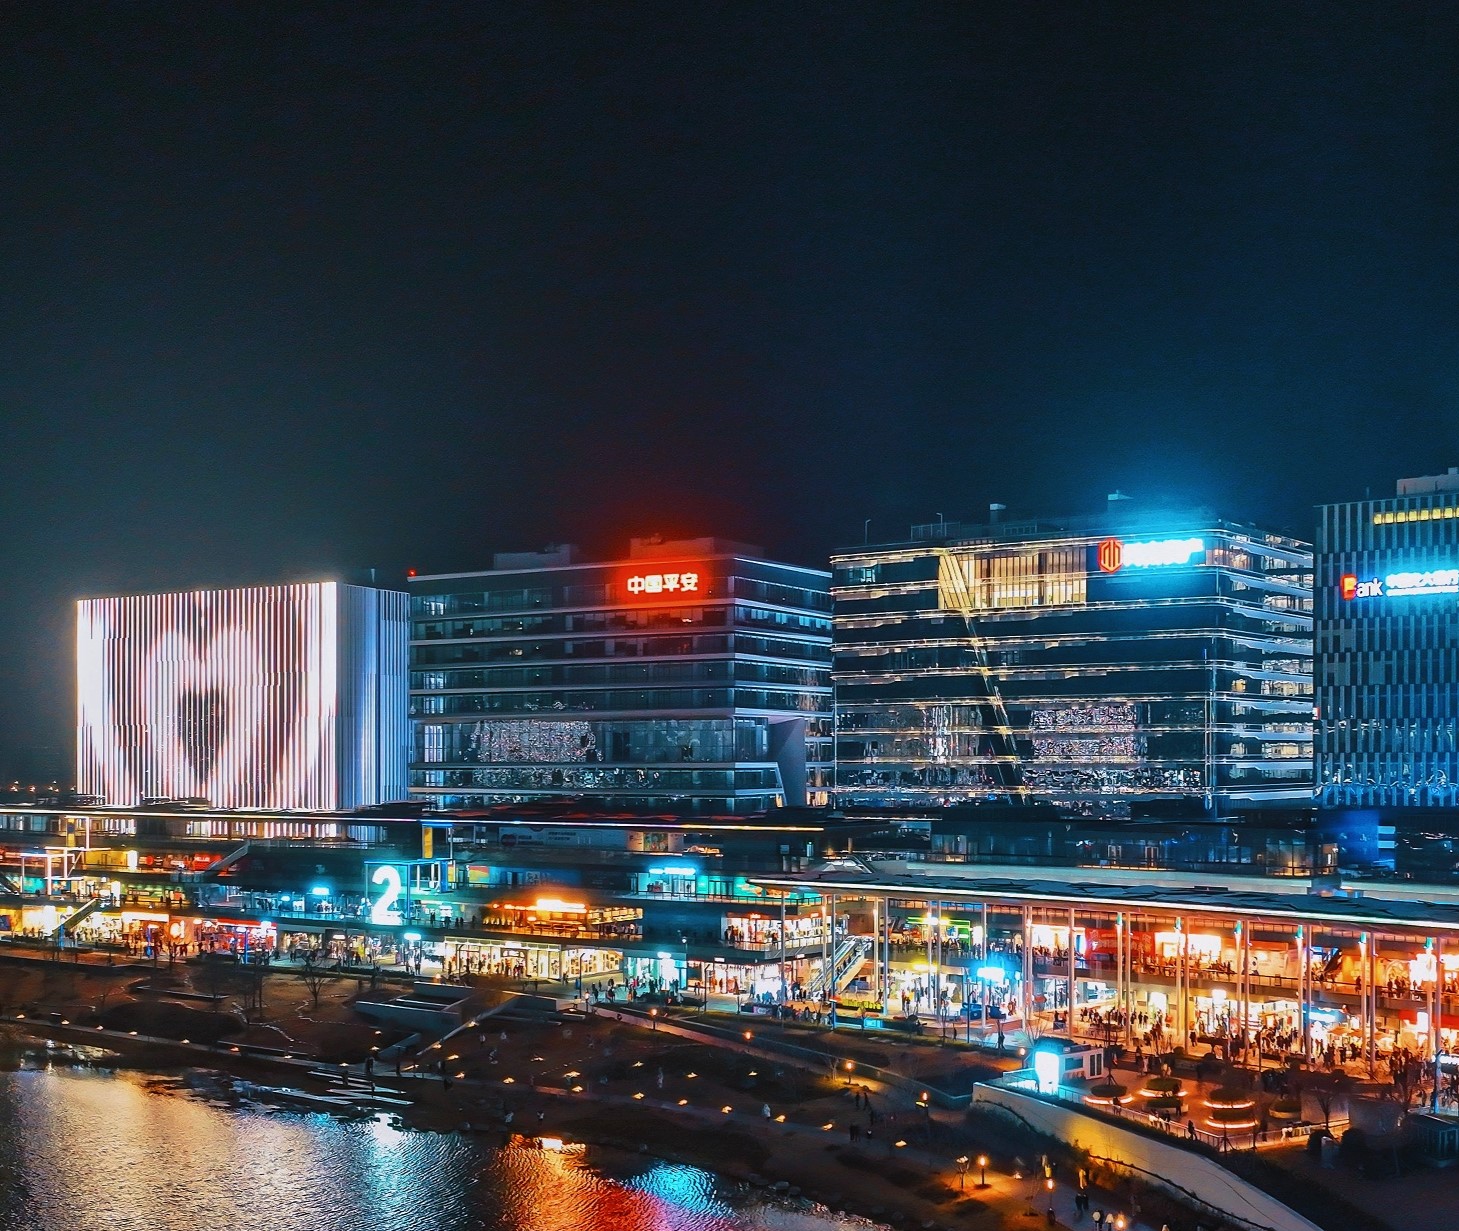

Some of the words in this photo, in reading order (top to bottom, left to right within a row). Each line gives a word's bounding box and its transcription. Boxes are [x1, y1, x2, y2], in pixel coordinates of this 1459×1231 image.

[627, 572, 698, 594] 中国平安
[372, 865, 402, 926] 2
